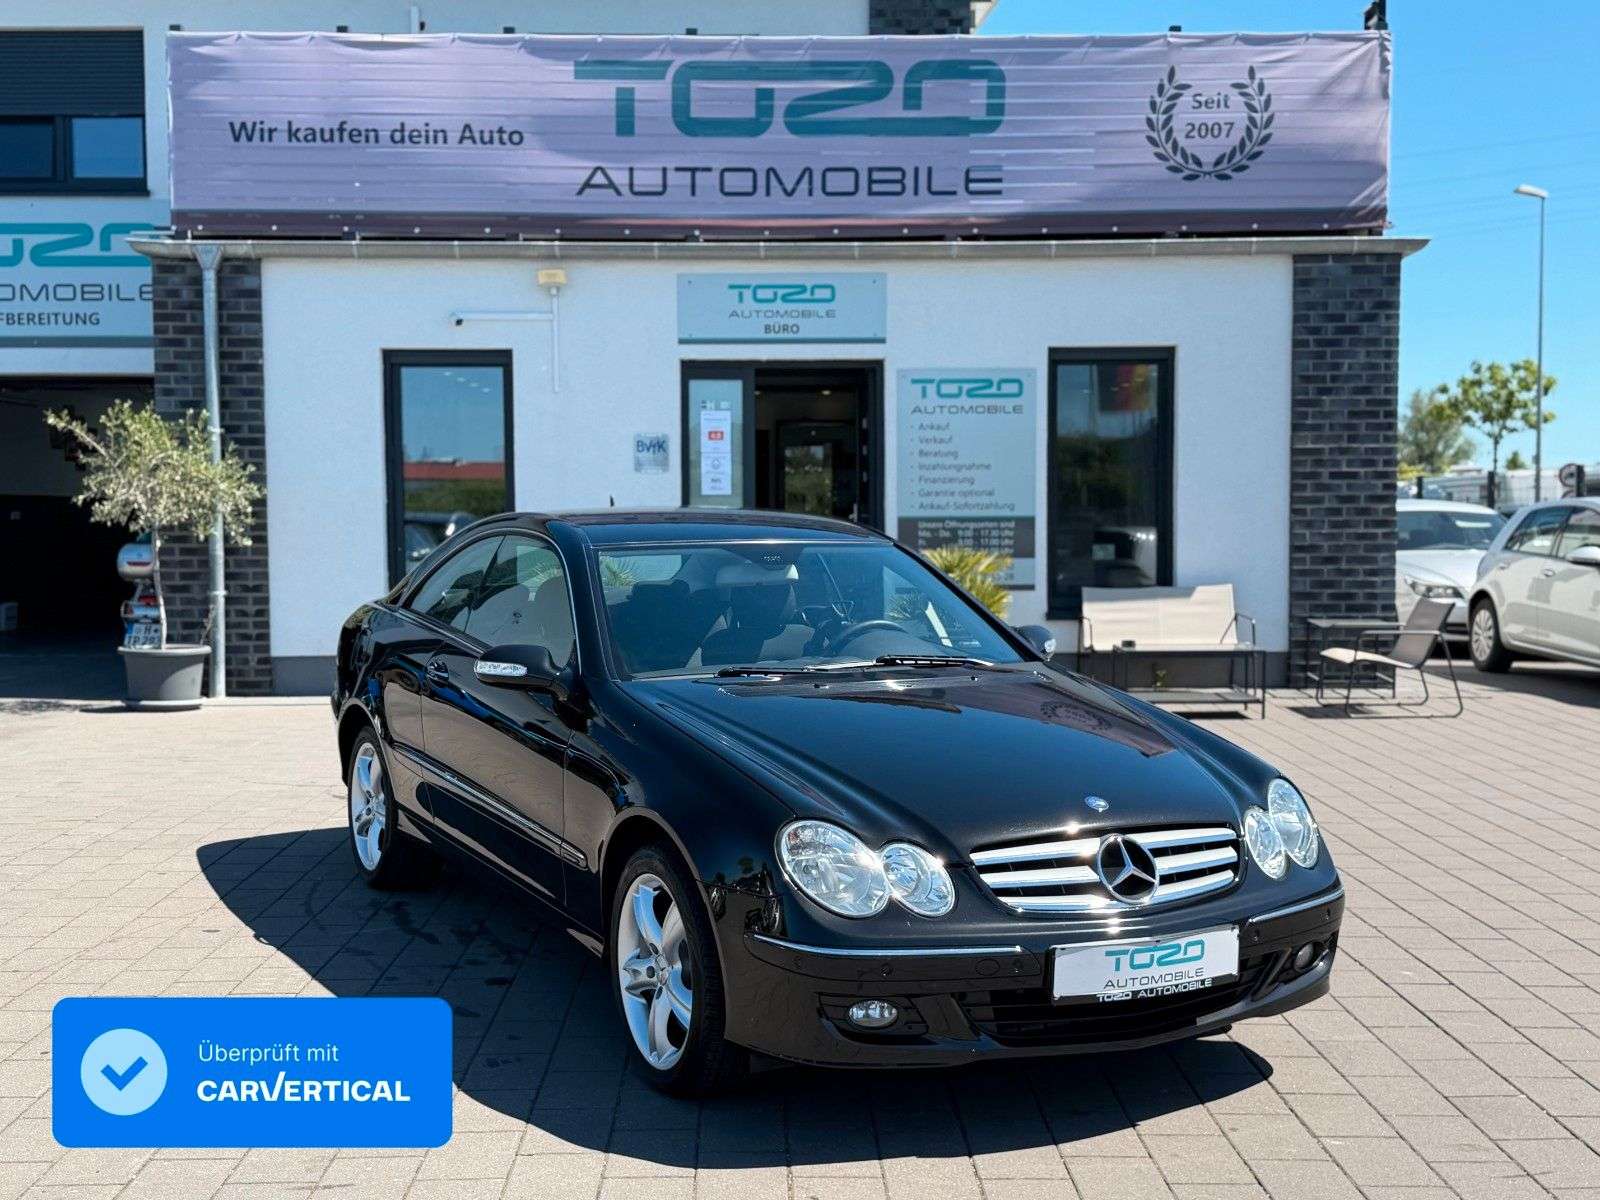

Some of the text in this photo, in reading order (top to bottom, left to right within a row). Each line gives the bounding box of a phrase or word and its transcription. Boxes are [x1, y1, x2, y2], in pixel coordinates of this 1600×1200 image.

[574, 58, 1006, 137] TOZO
[1191, 92, 1231, 110] Seit
[229, 120, 524, 146] Wir kaufen dein Auto
[1184, 121, 1235, 139] 2007
[575, 165, 1004, 196] AUTOMOBILE
[728, 283, 836, 304] TOZO
[728, 309, 837, 319] AUTOMOBILE
[910, 378, 1024, 399] TOZO
[910, 404, 1024, 415] AUTOMOBILE
[918, 422, 950, 431] Ankauf
[918, 435, 953, 444] Verkauf
[918, 449, 959, 460] Beratung
[918, 489, 995, 499] Garantie optional
[1104, 938, 1205, 972] TOZO
[1103, 967, 1205, 990] AUTOMOBILE
[1137, 978, 1213, 999] AUTOMOBILE
